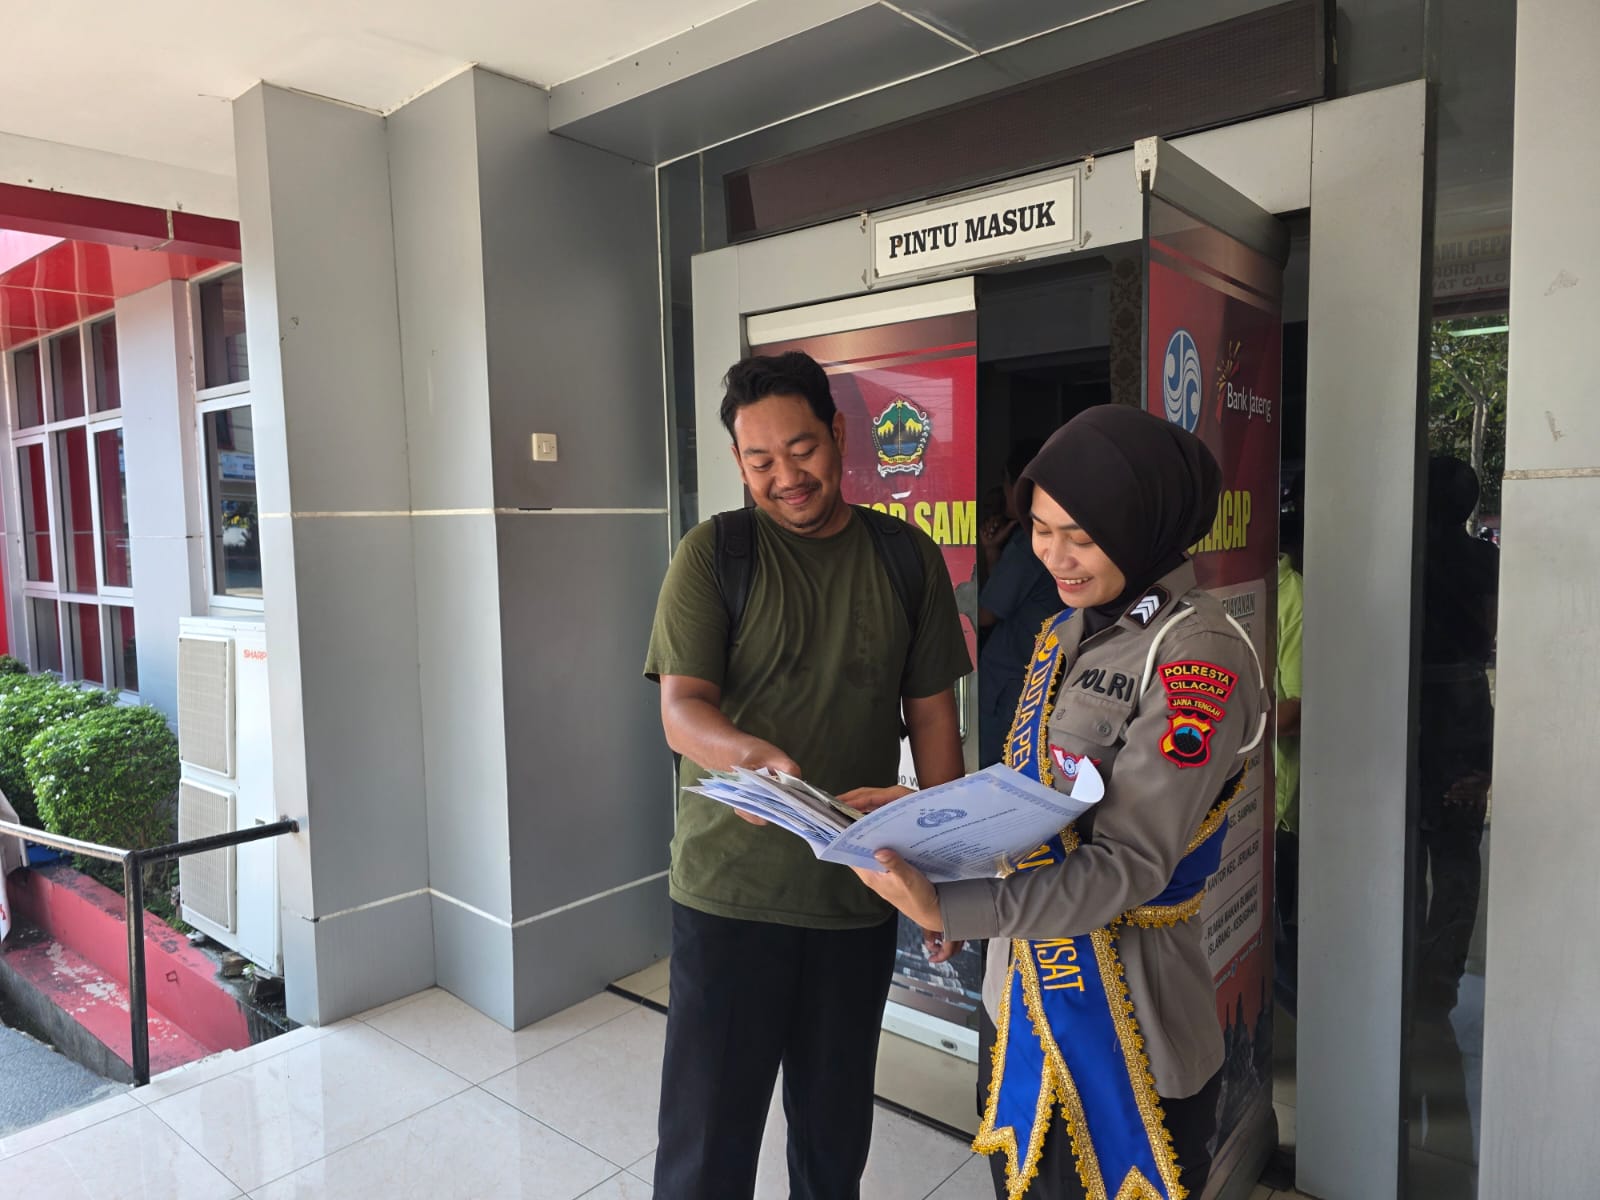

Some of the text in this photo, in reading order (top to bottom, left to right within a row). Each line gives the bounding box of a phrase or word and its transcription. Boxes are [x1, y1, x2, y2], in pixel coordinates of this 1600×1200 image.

[889, 200, 1056, 259] PINTU MASUK
[1227, 382, 1272, 423] Bank Jateng
[1187, 489, 1251, 555] ACAP
[243, 649, 268, 660] SHARP
[1164, 665, 1230, 685] POLRESTA
[1170, 681, 1225, 696] CILACAP
[1172, 698, 1221, 717] JAWA TENGAH
